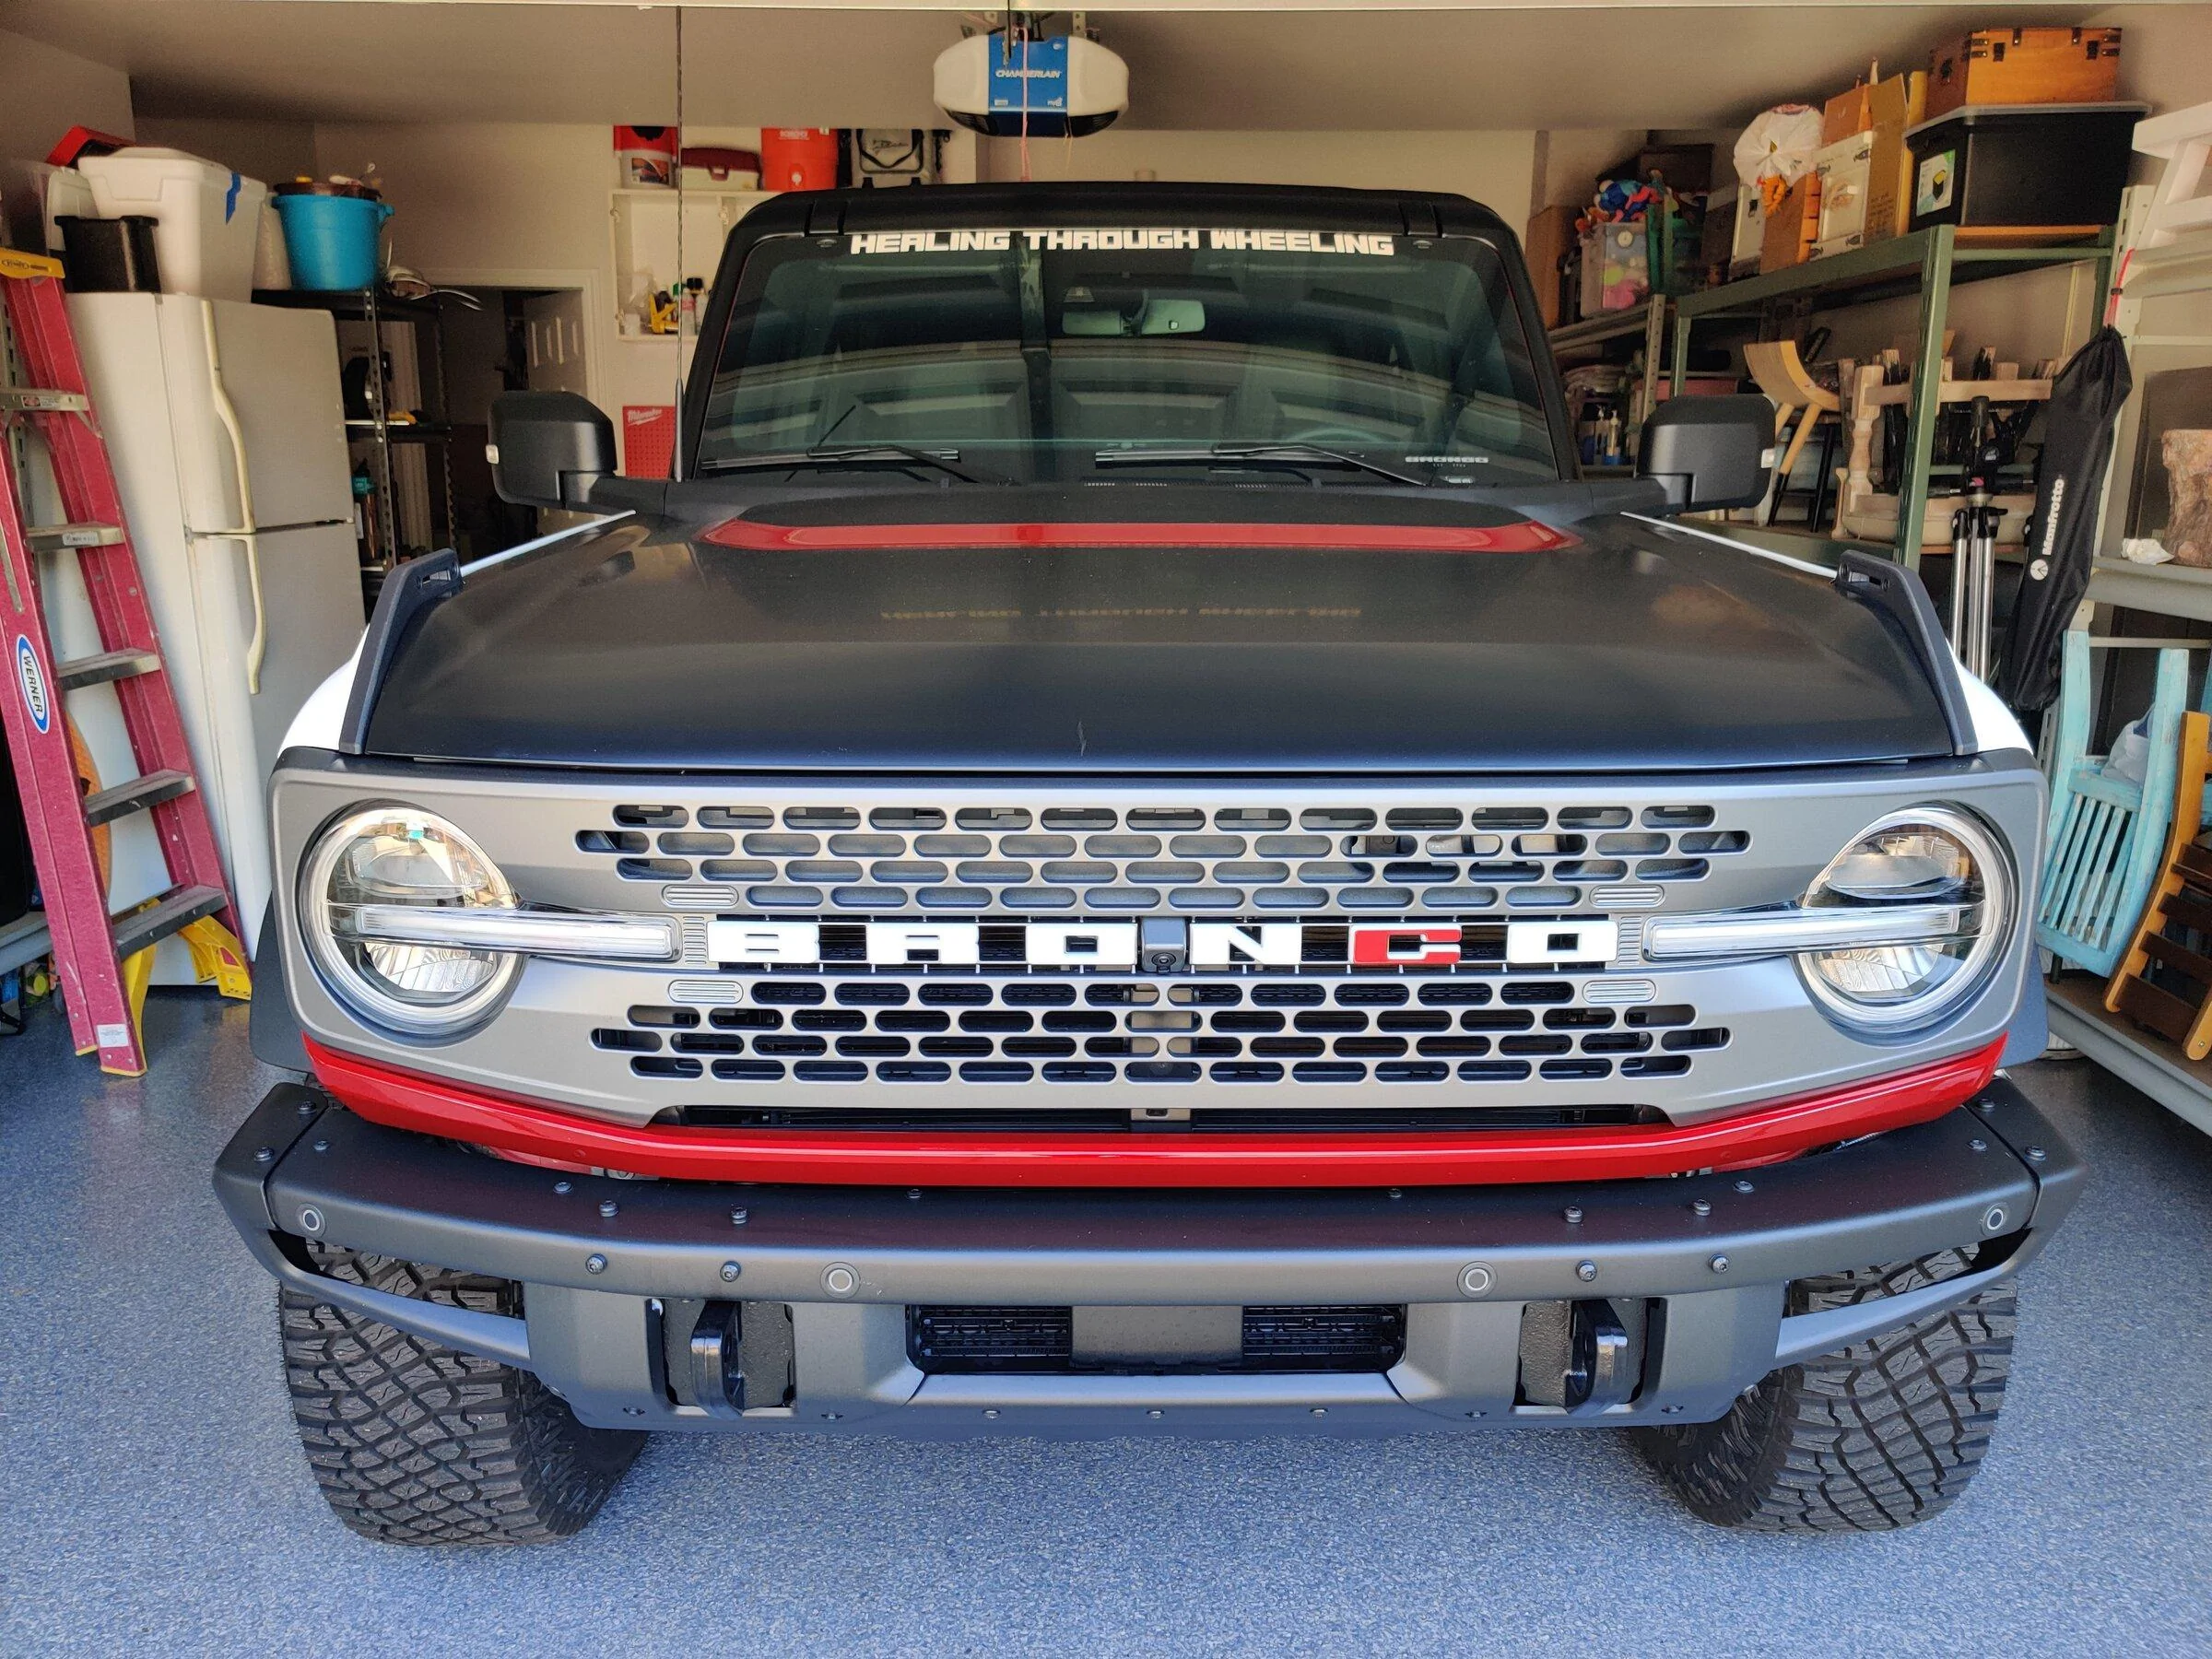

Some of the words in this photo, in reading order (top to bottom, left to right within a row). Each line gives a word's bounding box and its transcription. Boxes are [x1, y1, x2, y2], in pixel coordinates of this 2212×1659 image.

[851, 231, 1010, 254] HEALING
[1023, 229, 1199, 250] THROUGH
[1210, 230, 1394, 255] WHEELING
[2041, 478, 2065, 556] Manfrotto
[23, 655, 43, 712] WERNER
[708, 921, 1618, 966] BRONCO
